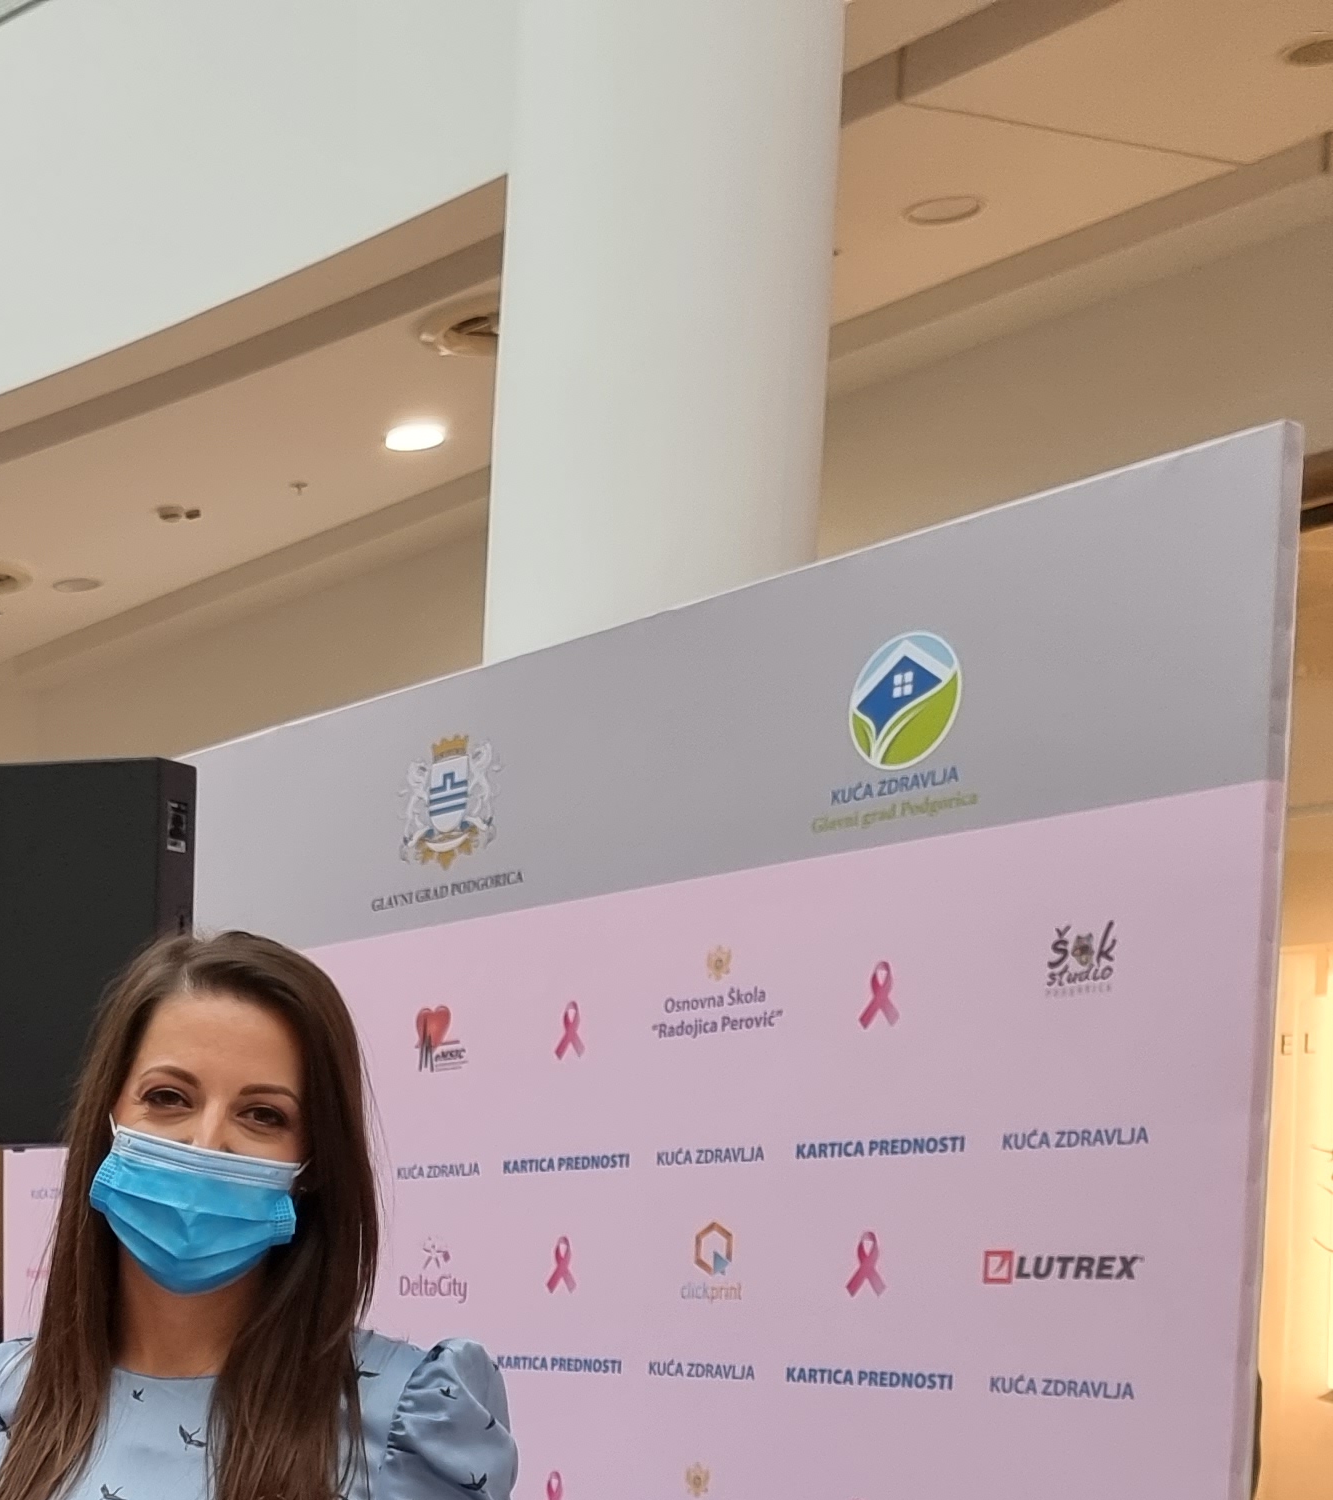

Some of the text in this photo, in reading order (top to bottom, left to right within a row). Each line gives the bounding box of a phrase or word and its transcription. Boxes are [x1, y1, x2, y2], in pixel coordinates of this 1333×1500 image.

[830, 766, 959, 805] KUĆA ZDRAVLJA
[371, 870, 524, 912] GLAVNI GRAD PODGORICA
[664, 986, 766, 1013] Osnovna Škola
[796, 1136, 965, 1159] KARTICA PREDNOSTI
[1002, 1126, 1148, 1150] KUĆA ZDRAVLJA
[503, 1153, 630, 1174] KARTICA PREDNOSTI
[657, 1146, 764, 1166] KUĆA ZDRAVLJA
[397, 1162, 480, 1180] KUĆA ZDRAVLJA
[1015, 1255, 1137, 1280] LUTREX
[399, 1275, 467, 1304] DeltaCity
[496, 1355, 622, 1374] KARTICA PREDNOSTI
[648, 1359, 754, 1380] KUĆA ZDRAVLJA
[786, 1366, 953, 1391] KARTICA PREDNOSTI
[989, 1375, 1134, 1401] KUĆA ZDRAVLJA
